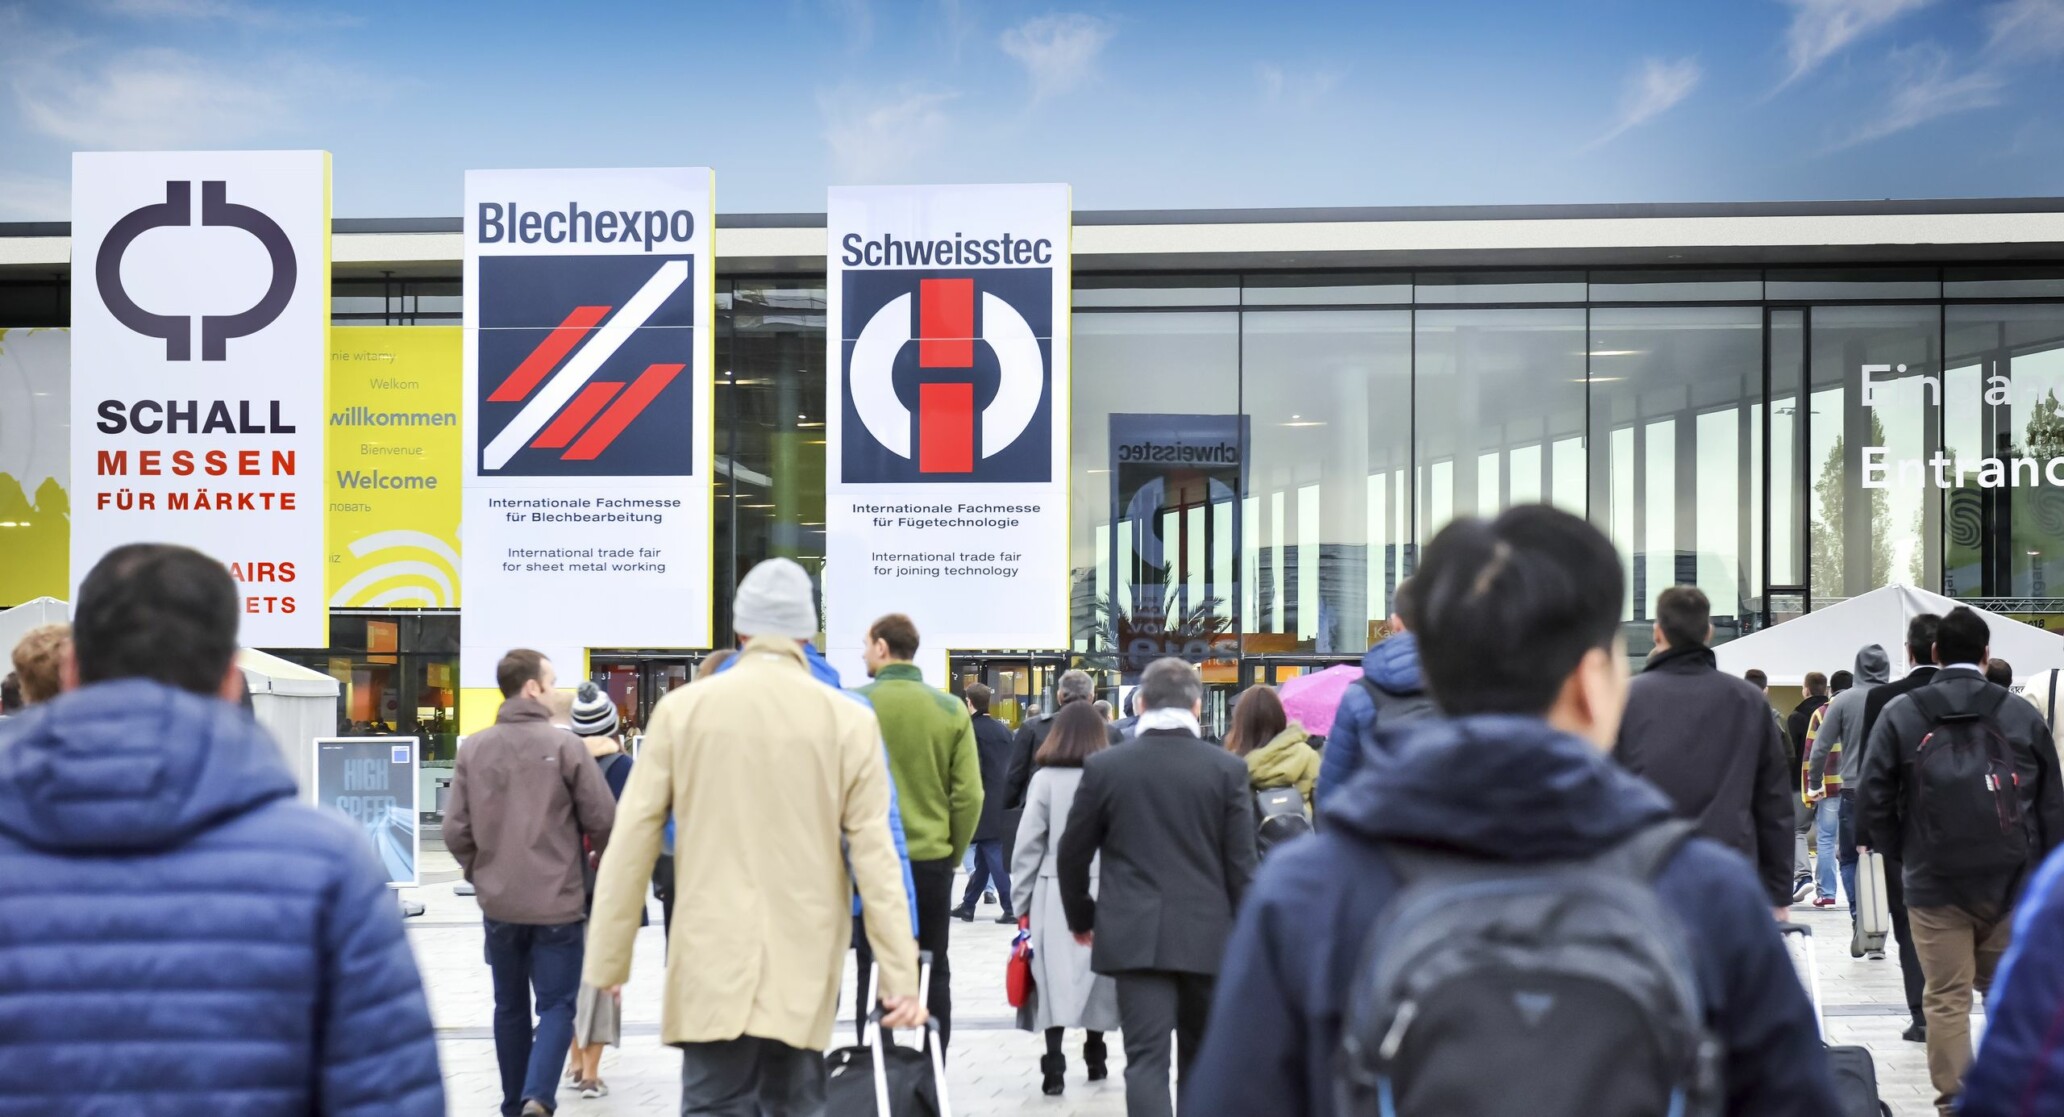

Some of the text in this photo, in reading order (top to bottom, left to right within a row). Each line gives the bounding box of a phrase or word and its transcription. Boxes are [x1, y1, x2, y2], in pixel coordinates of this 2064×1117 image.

[478, 201, 695, 253] Blechexpo
[841, 231, 1052, 267] Schweisstec
[330, 351, 396, 364] nie witamy
[369, 378, 420, 390] Welkom
[96, 399, 297, 435] SCHALL
[330, 406, 457, 427] willkommen
[360, 443, 424, 455] Bienvenue
[97, 449, 296, 477] MESSEN
[336, 469, 438, 489] Welcome
[97, 487, 296, 511] FÜR MÄRKTE
[488, 498, 681, 508] Internationale Fachmesse
[852, 503, 1041, 513] Internationale Fachmesse
[506, 512, 663, 524] für Blechbearbeitung
[873, 518, 1020, 529] für Fügetechnologie
[508, 548, 662, 558] International trade fair
[872, 552, 1022, 562] International trade fair
[502, 562, 666, 574] for sheet metal working
[874, 566, 1019, 578] for joining technology
[344, 758, 389, 791] HIGH
